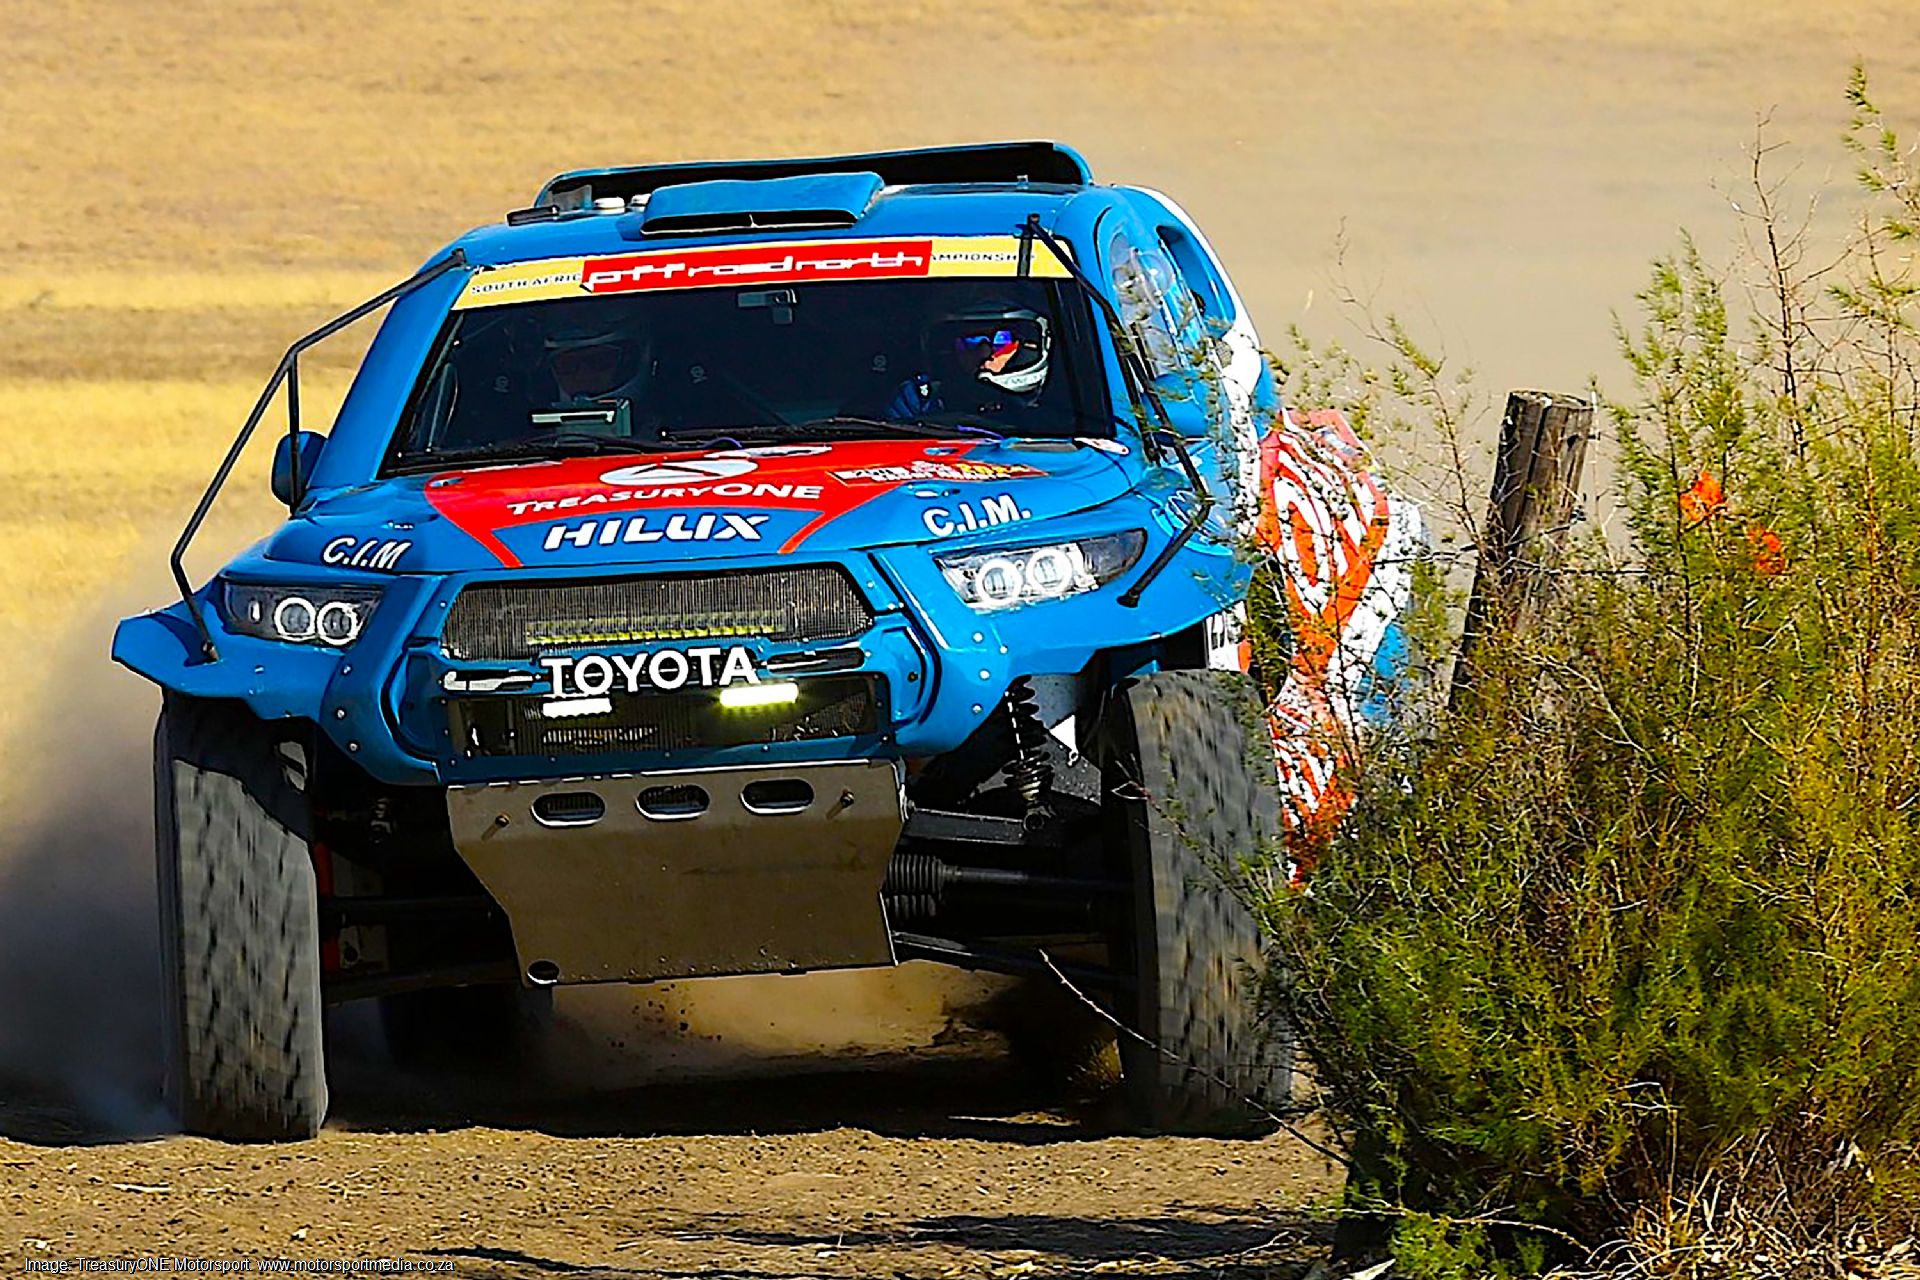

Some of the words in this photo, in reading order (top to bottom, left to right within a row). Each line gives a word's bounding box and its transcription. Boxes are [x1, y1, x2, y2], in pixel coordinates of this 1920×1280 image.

[931, 253, 1034, 262] MPIONSH
[543, 514, 770, 551] HILUX
[922, 494, 1033, 538] C.I.M.
[541, 646, 762, 697] TOYOTA
